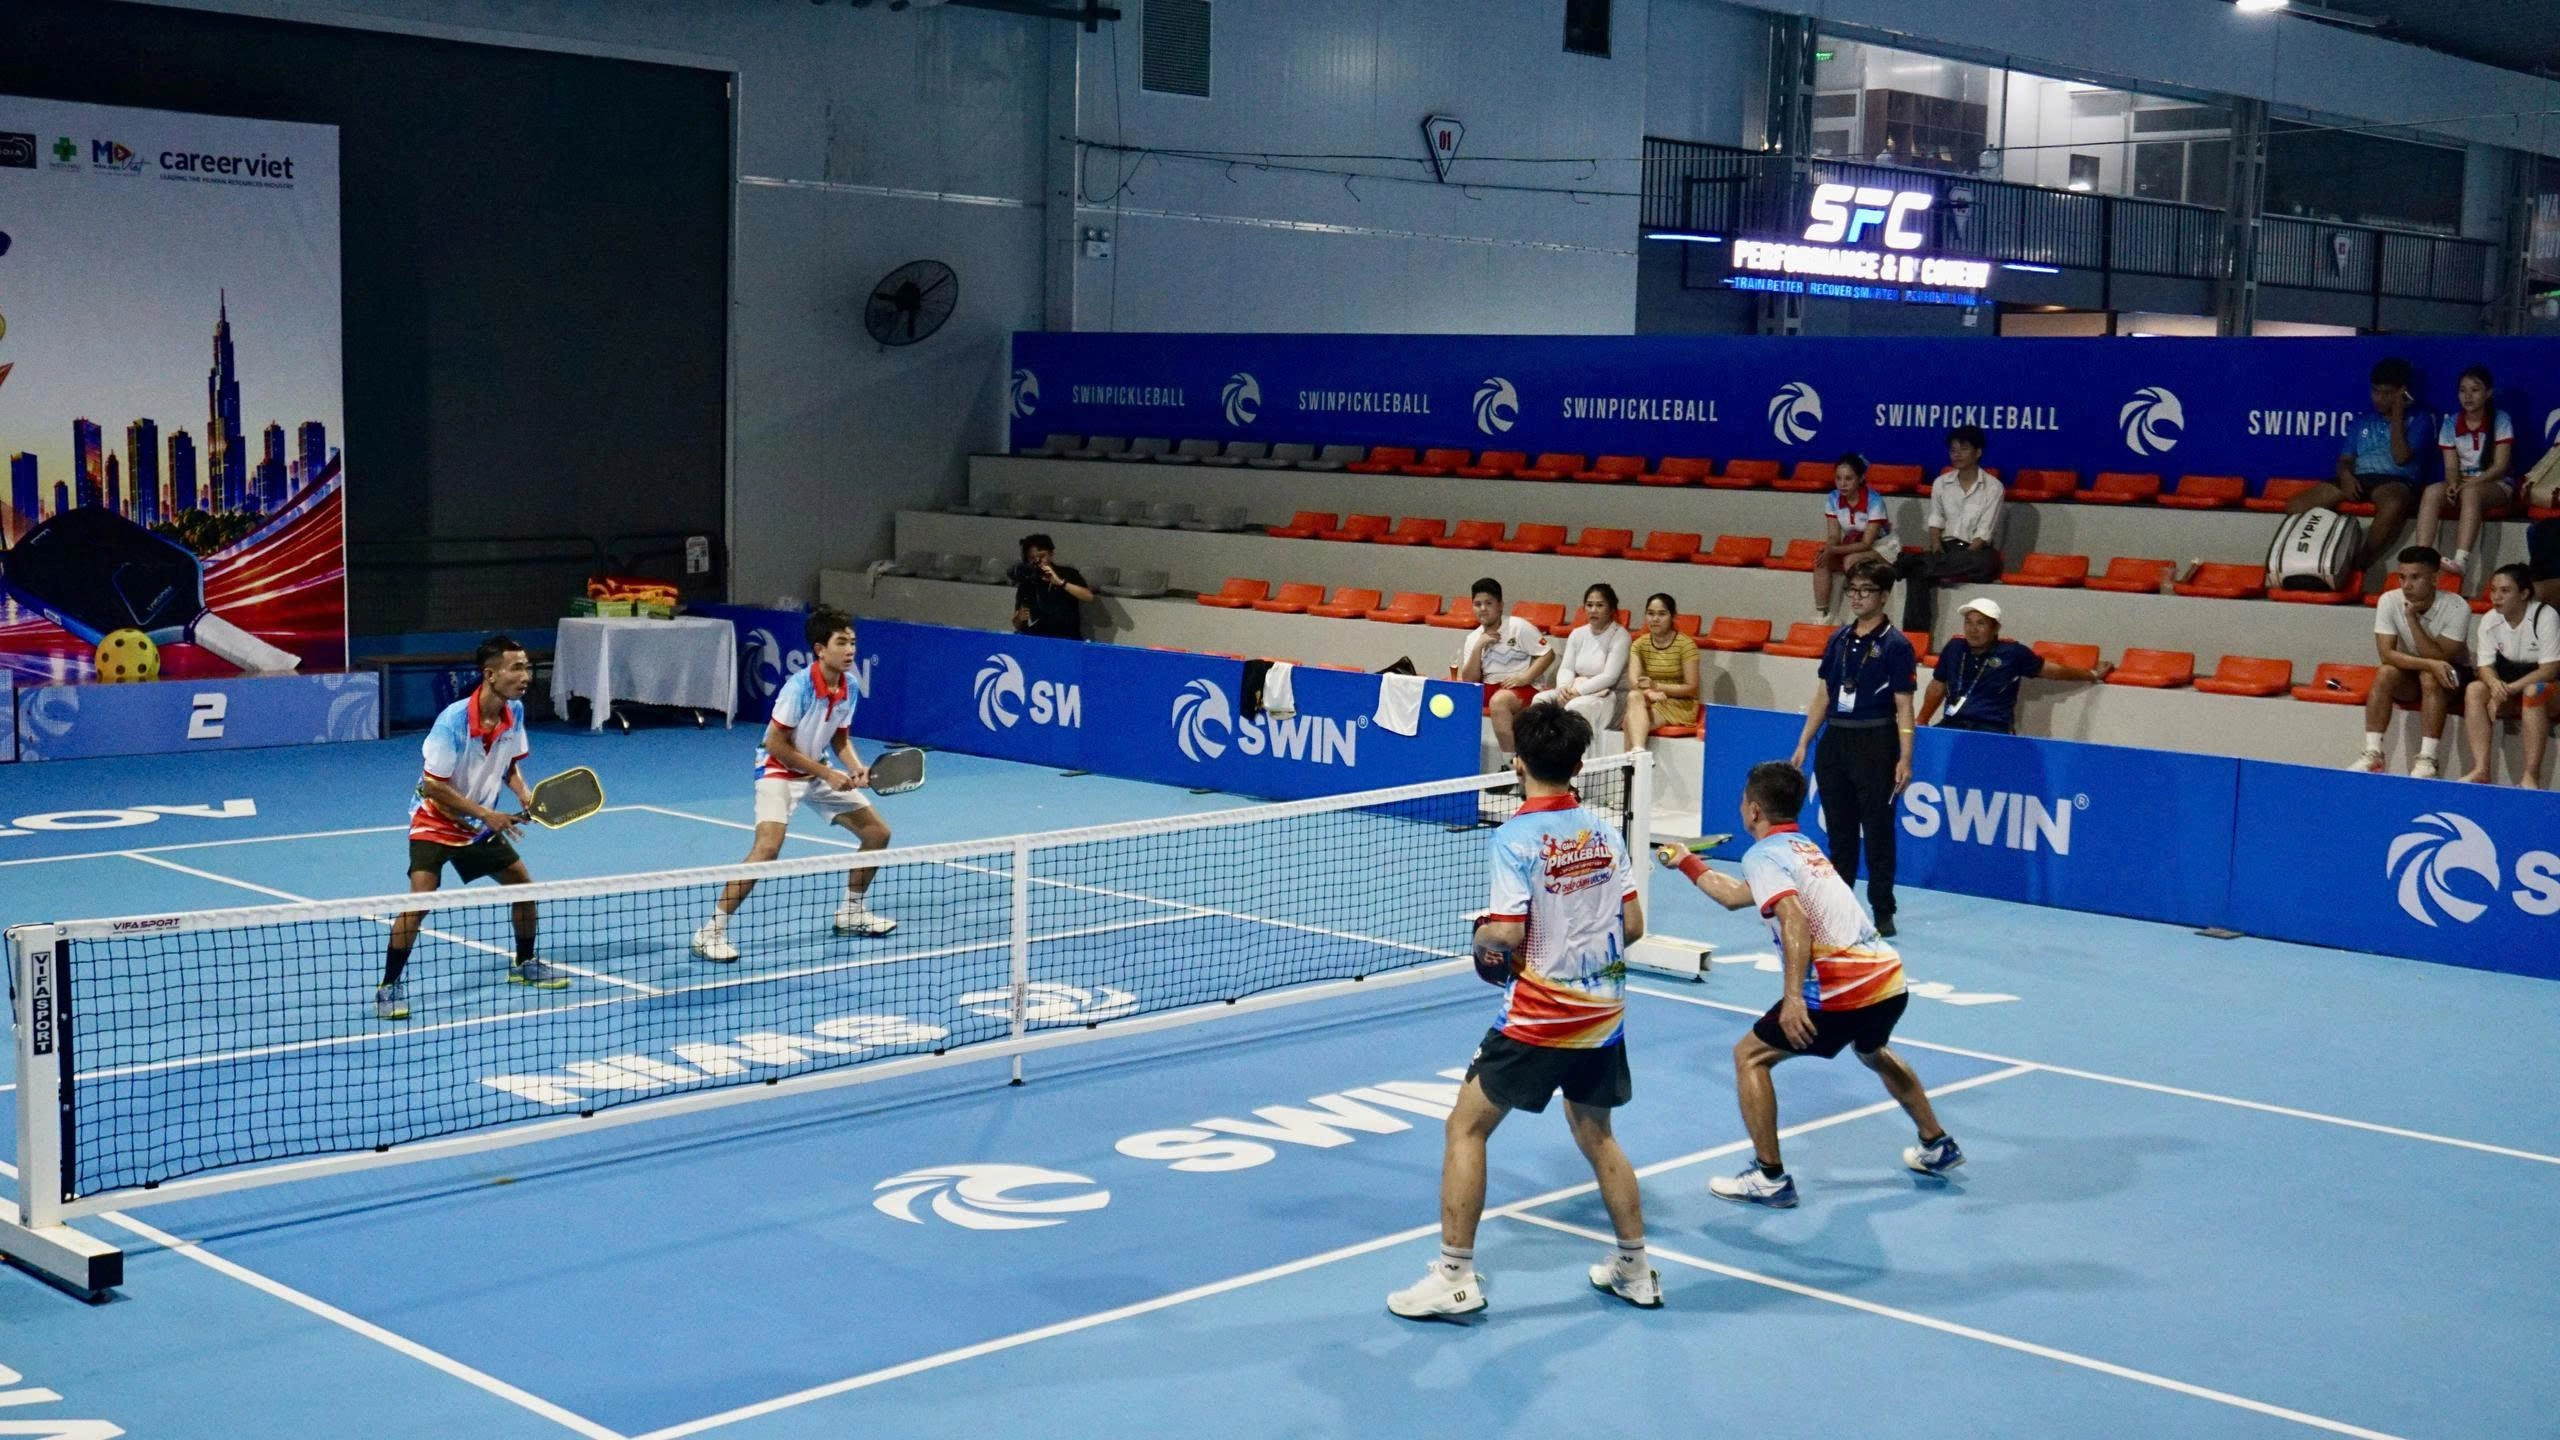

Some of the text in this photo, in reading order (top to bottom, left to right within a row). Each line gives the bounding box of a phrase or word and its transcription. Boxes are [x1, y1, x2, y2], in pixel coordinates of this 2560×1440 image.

[160, 152, 294, 179] careerviet
[1804, 183, 1933, 250] SFC
[1072, 384, 1186, 407] SWINPICKLEBALL
[1298, 390, 1431, 414] SWINPICKLEBALL
[1562, 397, 1719, 422] SWINPICKLEBALL
[1875, 403, 2060, 431] SWINPICKLEBALL
[2248, 409, 2355, 437] SWINPIC
[187, 692, 229, 740] 2
[1545, 845, 1613, 876] PICKLEBALL
